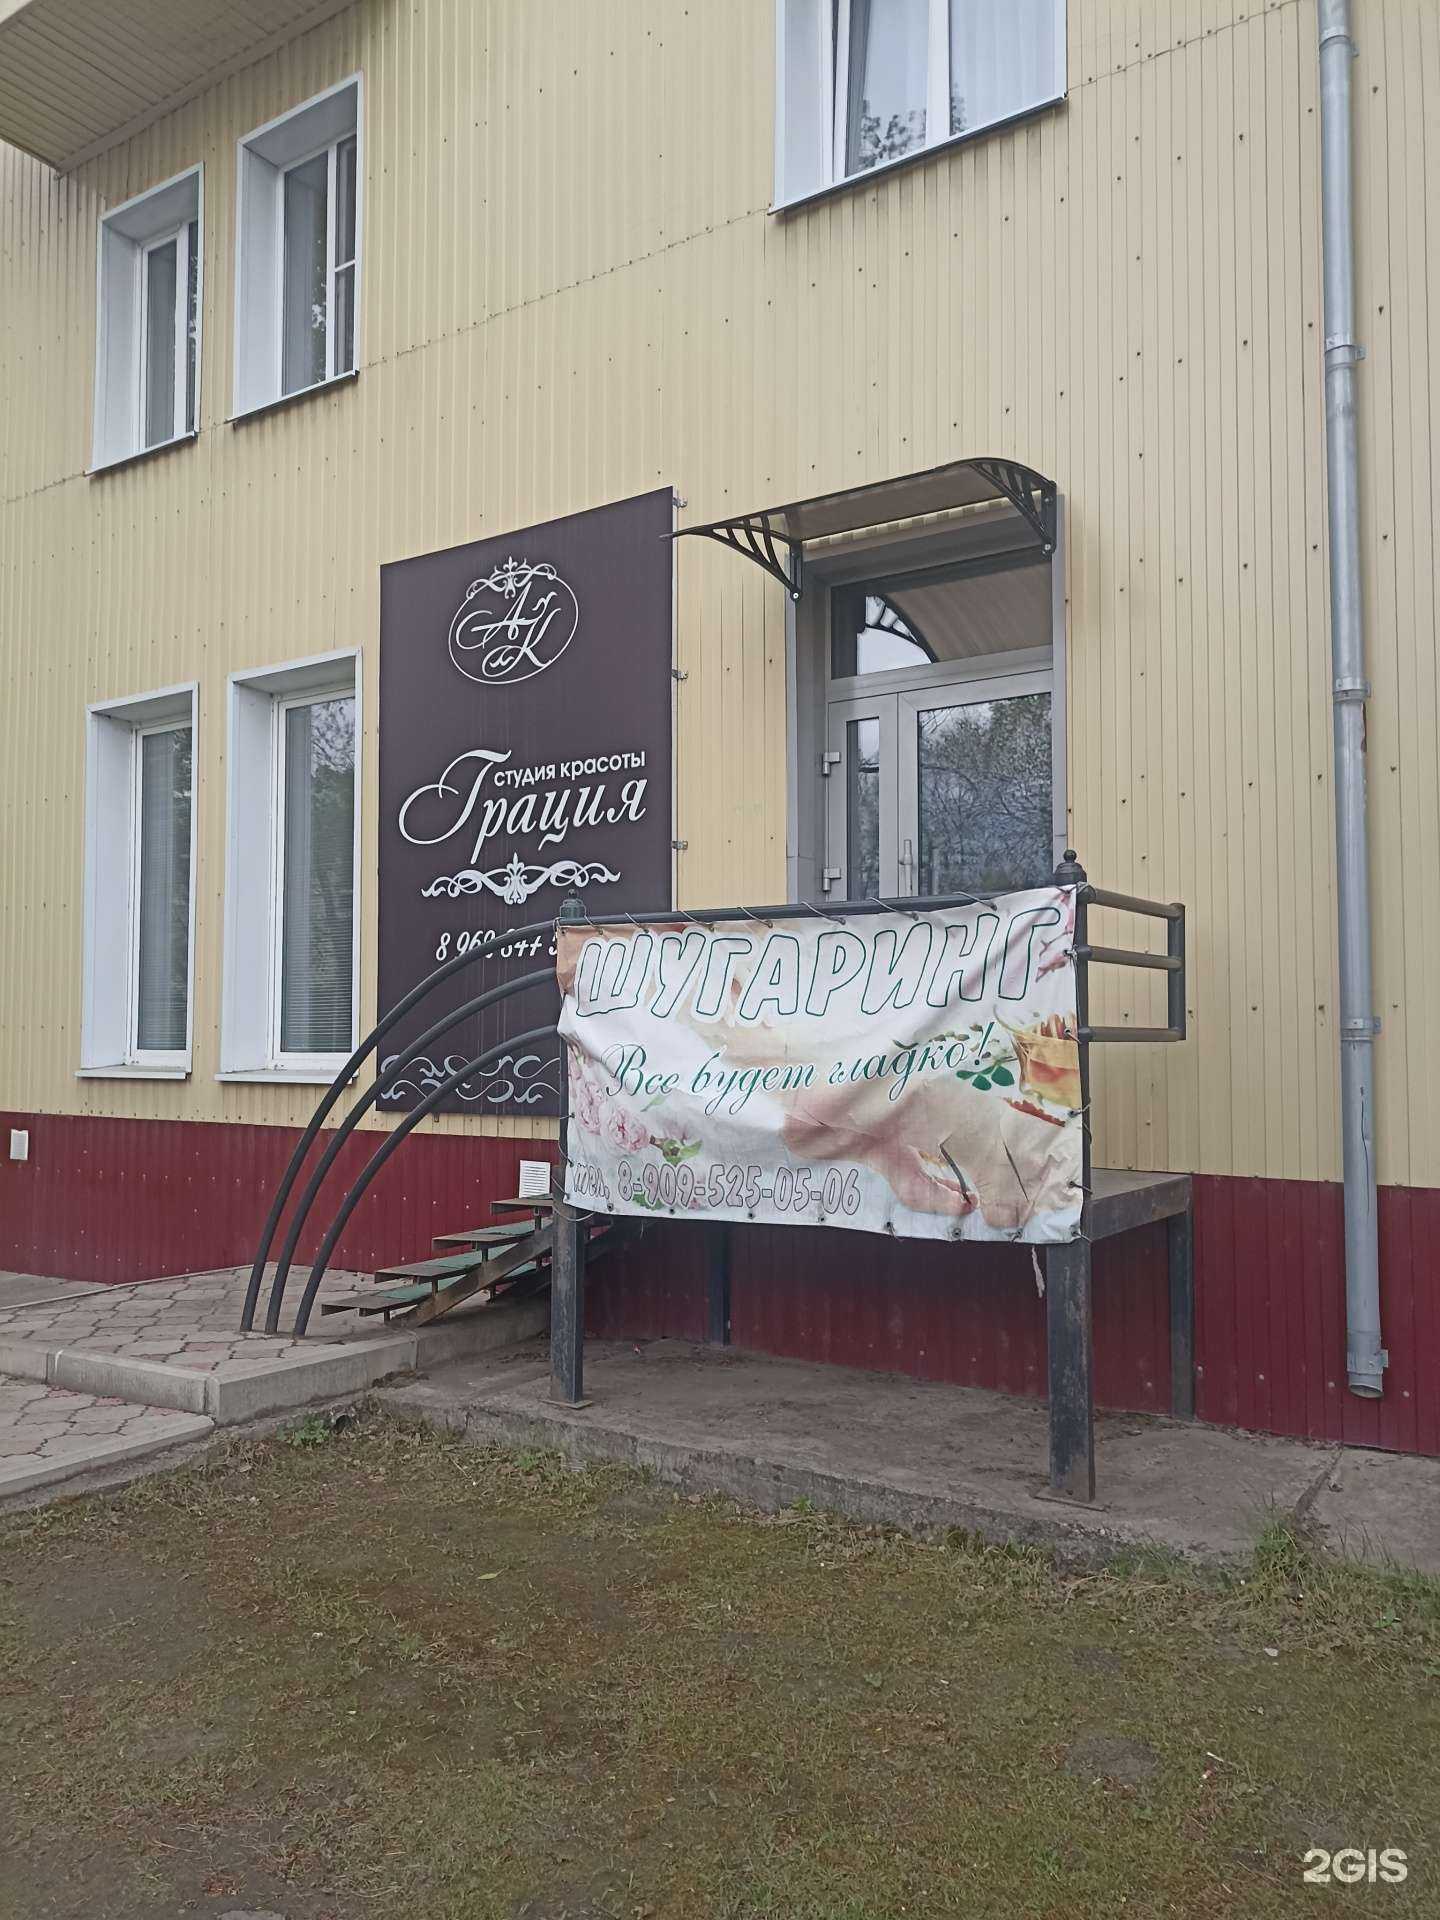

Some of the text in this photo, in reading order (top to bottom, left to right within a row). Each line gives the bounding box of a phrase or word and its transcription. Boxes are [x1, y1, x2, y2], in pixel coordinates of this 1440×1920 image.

[398, 749, 648, 865] Грация
[493, 751, 646, 788] студия красоты
[435, 932, 451, 961] 8
[575, 906, 1061, 1021] ШУГАРИНГ
[600, 1021, 996, 1116] Все будет гладко!
[617, 1160, 862, 1216] 8-909-525-05-06
